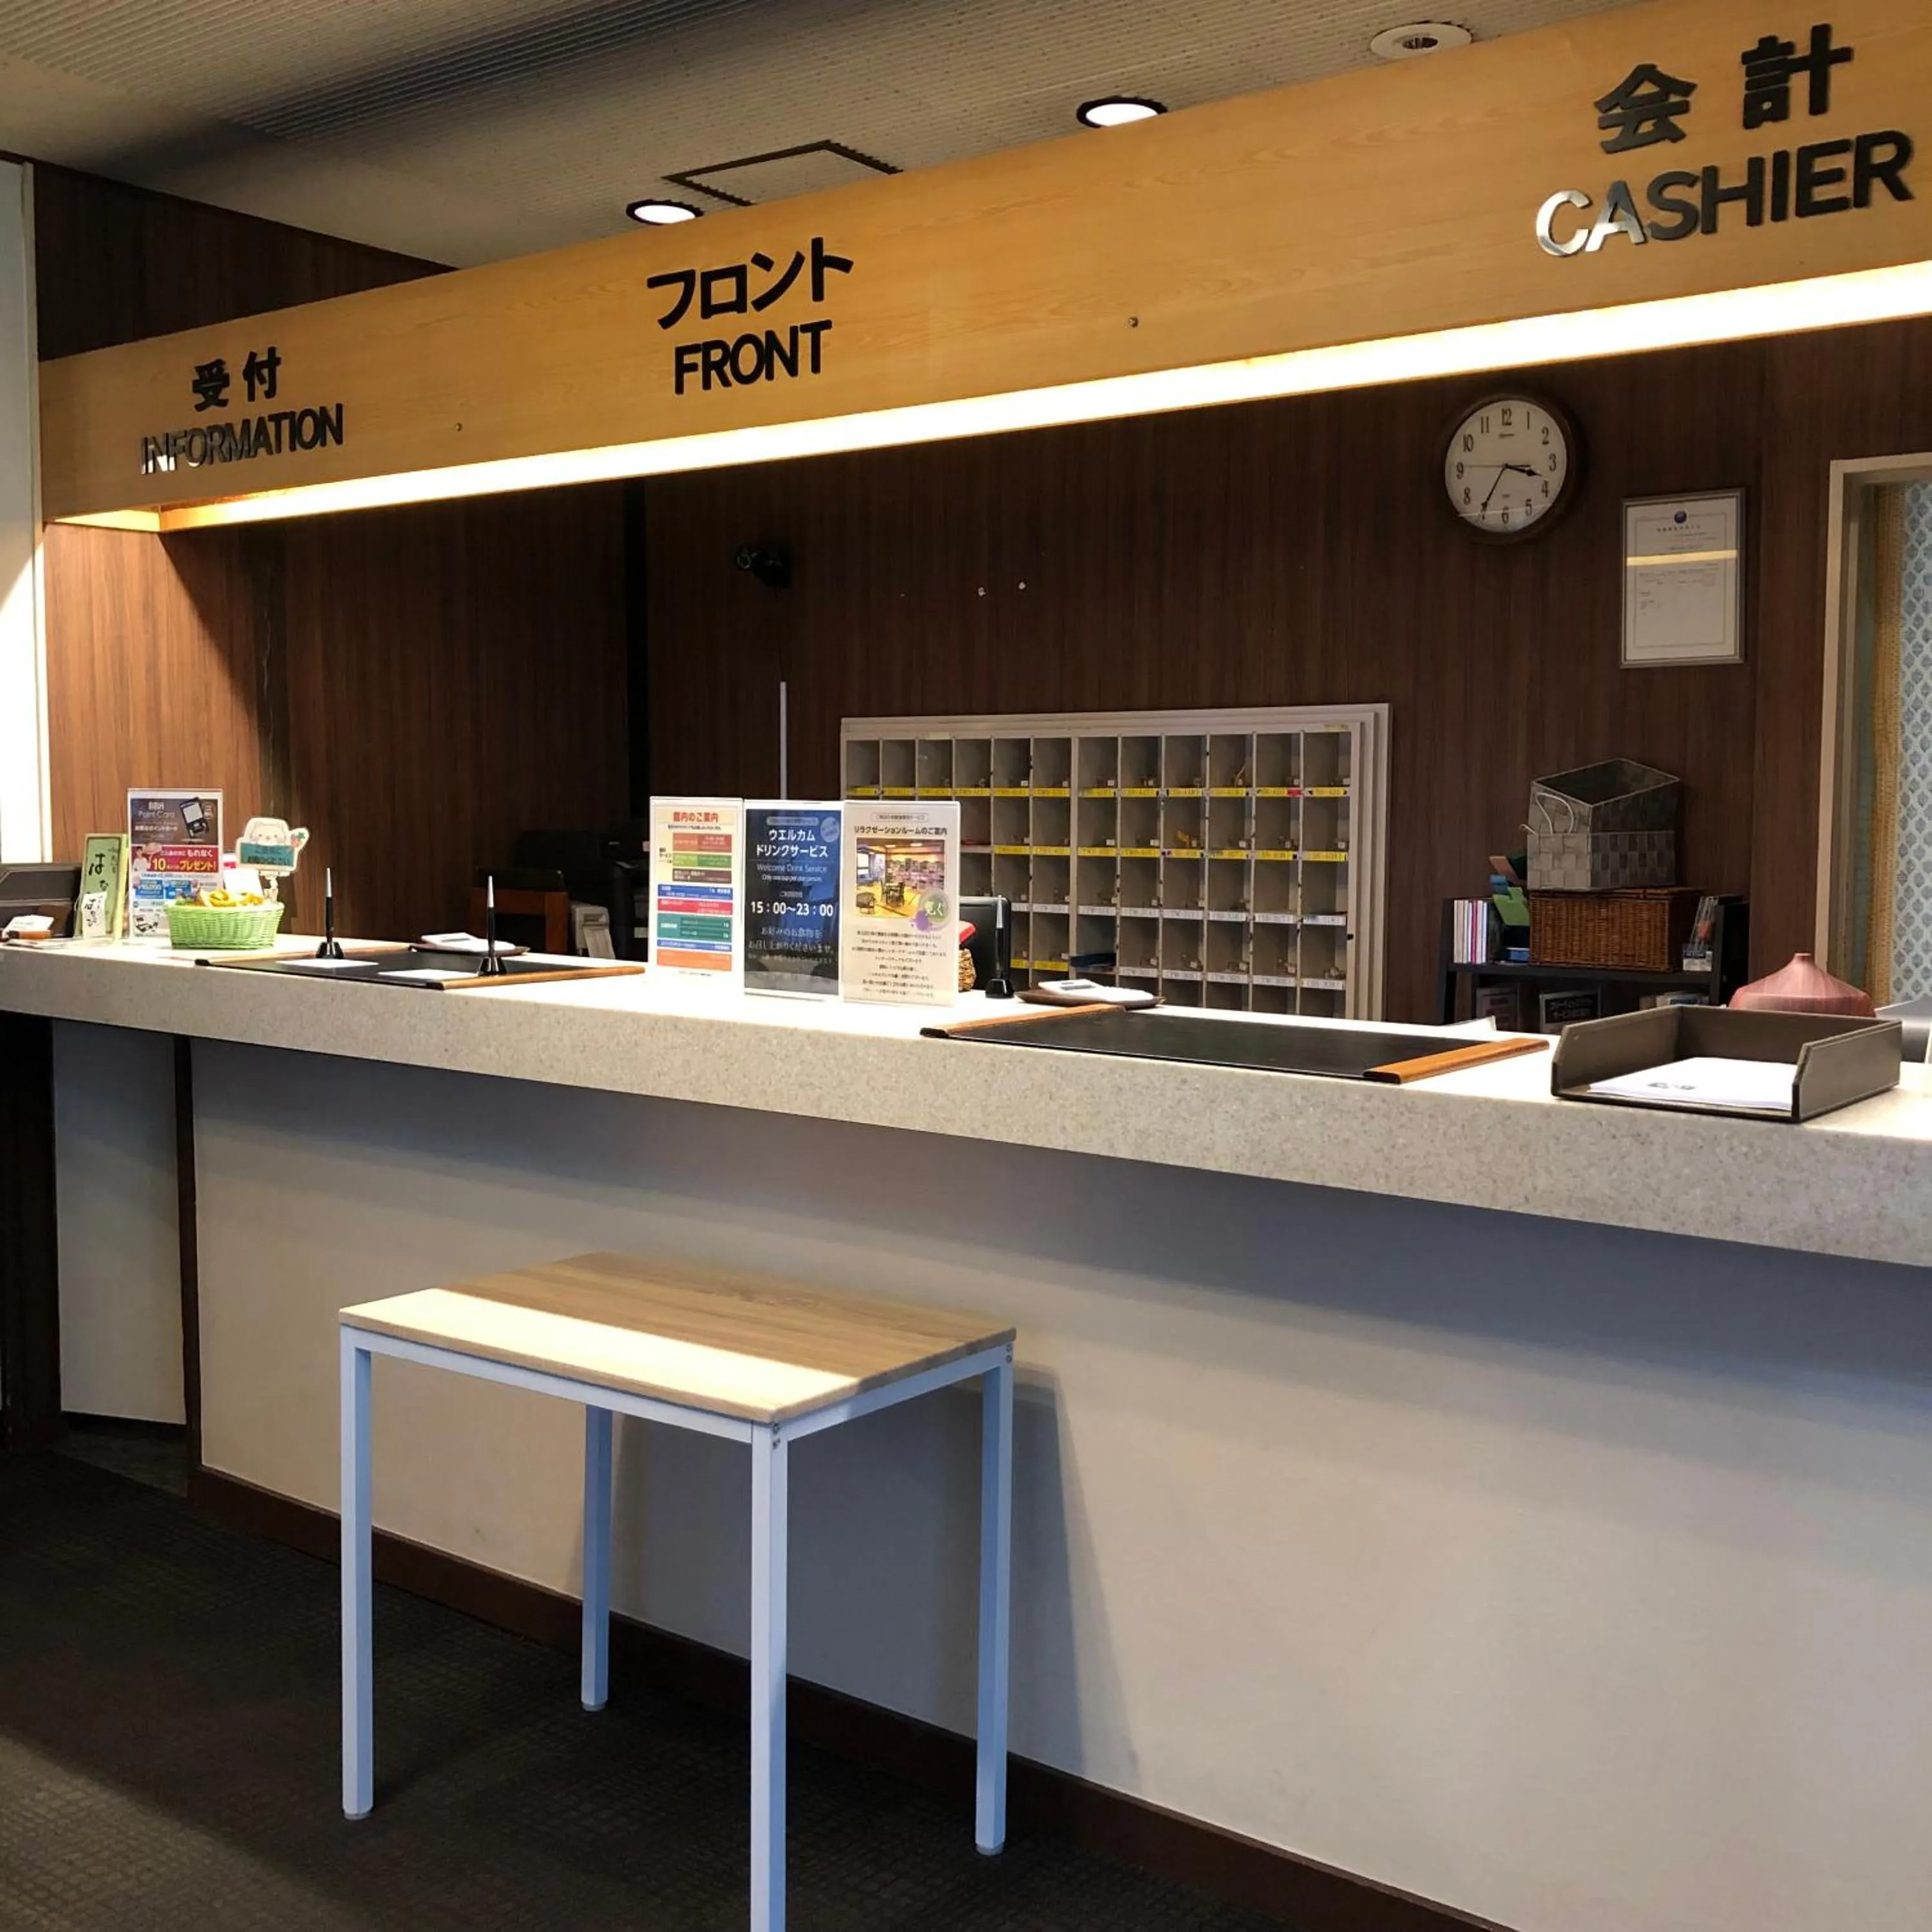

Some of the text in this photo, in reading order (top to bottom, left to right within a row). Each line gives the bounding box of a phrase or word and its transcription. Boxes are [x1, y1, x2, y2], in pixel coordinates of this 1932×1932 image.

[1593, 23, 1854, 154] 会計
[1535, 129, 1915, 257] CASHIER
[646, 236, 855, 330] フロント
[674, 319, 833, 395] FRONT
[191, 346, 282, 413] 受付
[1481, 415, 1490, 433] 11
[1501, 407, 1512, 426] 12
[140, 402, 343, 475] INFORMATION
[1463, 433, 1474, 452] 10
[1541, 426, 1549, 445] 2
[1456, 462, 1464, 479] 9
[1548, 453, 1557, 471] 3
[1463, 487, 1471, 505] 8
[1540, 480, 1549, 497] 4
[1501, 506, 1509, 524] 6
[1525, 498, 1533, 516] 5
[768, 829, 816, 842] ウエルカム
[756, 844, 829, 858] ドリンクサービス
